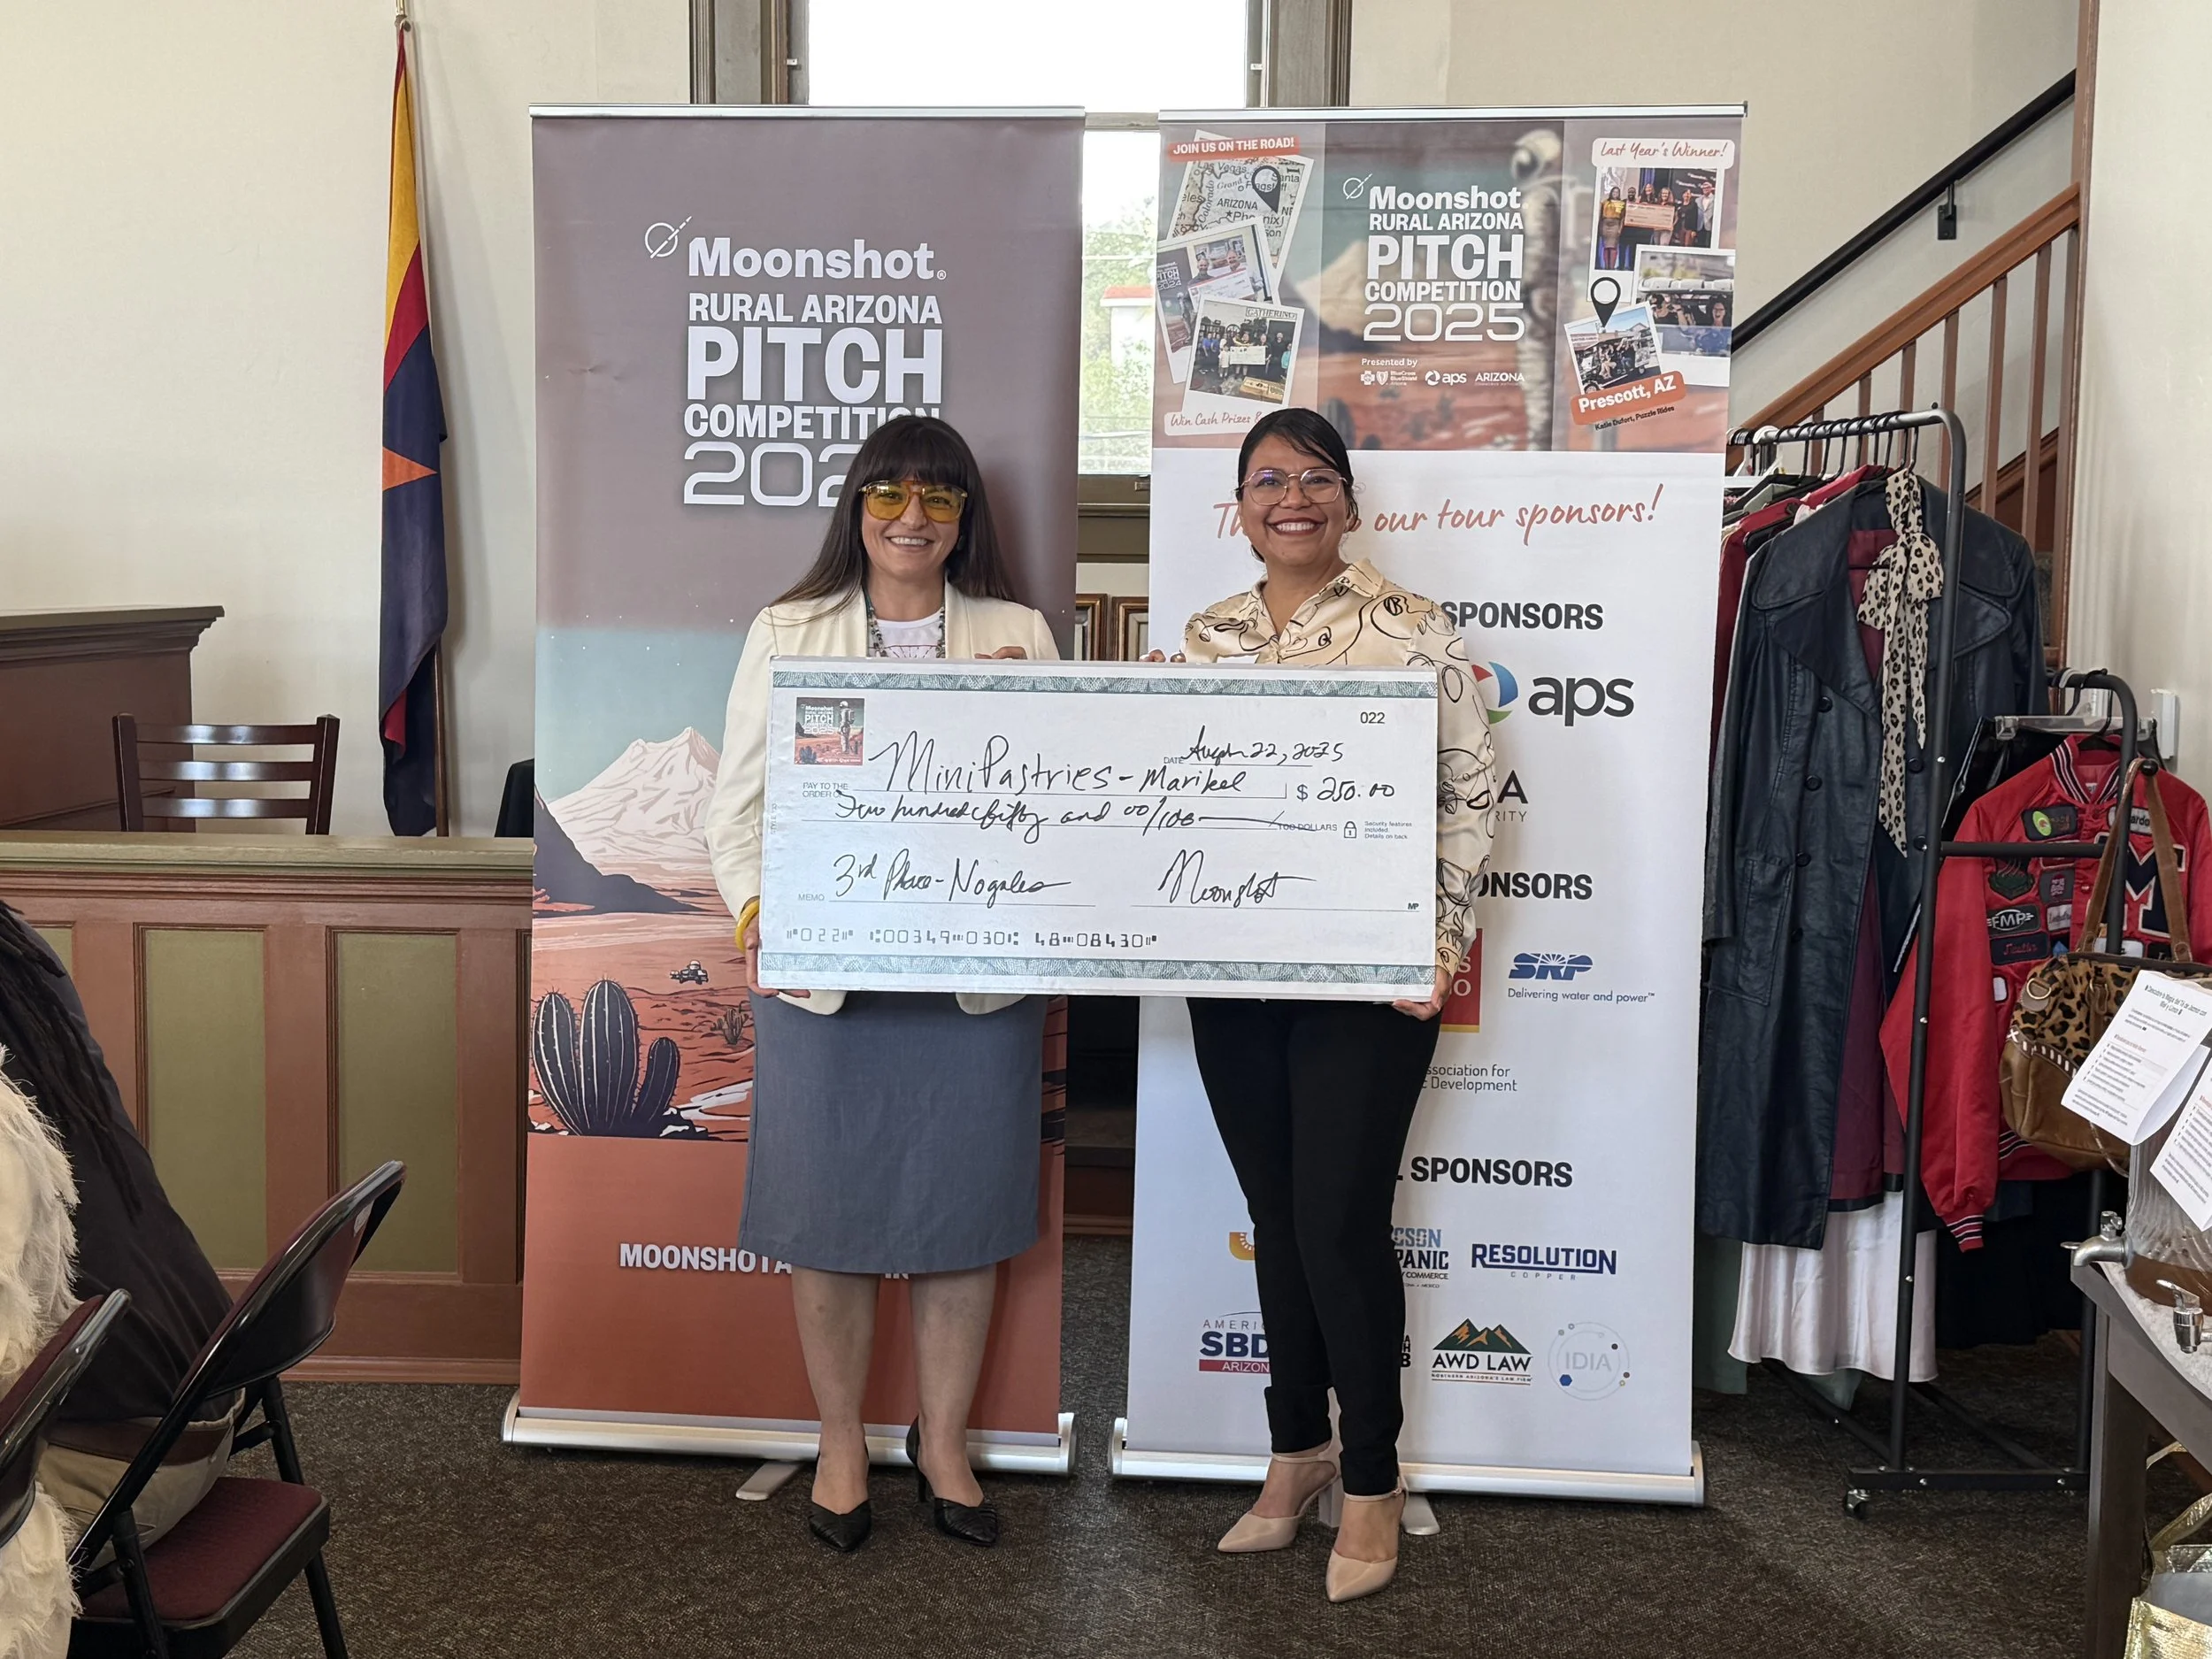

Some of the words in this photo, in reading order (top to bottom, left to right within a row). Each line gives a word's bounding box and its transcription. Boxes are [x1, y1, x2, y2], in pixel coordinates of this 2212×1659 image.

[1173, 142, 1199, 155] JOIN
[1202, 142, 1217, 154] US
[1218, 141, 1234, 151] ON
[1236, 139, 1258, 150] THE
[1260, 137, 1294, 150] ROAD!
[1601, 142, 1625, 157] Last
[1631, 142, 1669, 159] Year's
[1672, 142, 1728, 157] Winner!
[1217, 198, 1258, 210] ARIZONA
[1369, 185, 1522, 210] Moonshot
[1369, 213, 1433, 231] RURAL
[1437, 212, 1524, 230] ARIZONA
[688, 237, 934, 280] Moonshot
[1367, 234, 1524, 280] PITCH
[1364, 280, 1521, 302] COMPETITION
[688, 293, 793, 322] RURAL
[802, 295, 942, 324] ARIZONA
[1363, 303, 1525, 342] 2025
[687, 326, 942, 404] PITCH
[1361, 357, 1405, 366] Presented
[1407, 358, 1418, 368] by
[1442, 373, 1467, 386] aps
[1475, 372, 1525, 382] ARIZONA
[1578, 384, 1652, 413] Prescott,
[1654, 375, 1677, 394] AZ
[684, 403, 940, 440] COMPETITI
[1171, 414, 1191, 426] Win
[1195, 411, 1217, 426] Cash
[1222, 412, 1251, 424] Prizes
[1374, 512, 1428, 533] our
[1438, 498, 1505, 530] tour
[1516, 483, 1663, 546] sponsors!
[1441, 601, 1603, 630] SPONSORS
[1528, 677, 1634, 726] aps
[804, 714, 833, 724] PITCH
[1360, 711, 1386, 724] 022
[1296, 783, 1309, 803] $
[1060, 802, 1112, 825] and
[1297, 823, 1338, 832] DOLLARS
[798, 893, 825, 902] MEMO
[1509, 952, 1593, 980] SRP
[1508, 987, 1558, 1002] Delivering
[1562, 991, 1590, 1001] water
[1593, 989, 1613, 1002] and
[1492, 1064, 1510, 1077] for
[1432, 1076, 1517, 1094] Development
[1410, 1156, 1573, 1187] SPONSORS
[1471, 1243, 1617, 1274] RESOLUTION
[1406, 1271, 1449, 1280] COMMERCE
[1510, 1271, 1576, 1281] COPPER
[1202, 1318, 1265, 1331] AMERI
[1432, 1353, 1479, 1370] AWD
[1487, 1355, 1532, 1372] LAW
[1565, 1352, 1611, 1371] IDIA
